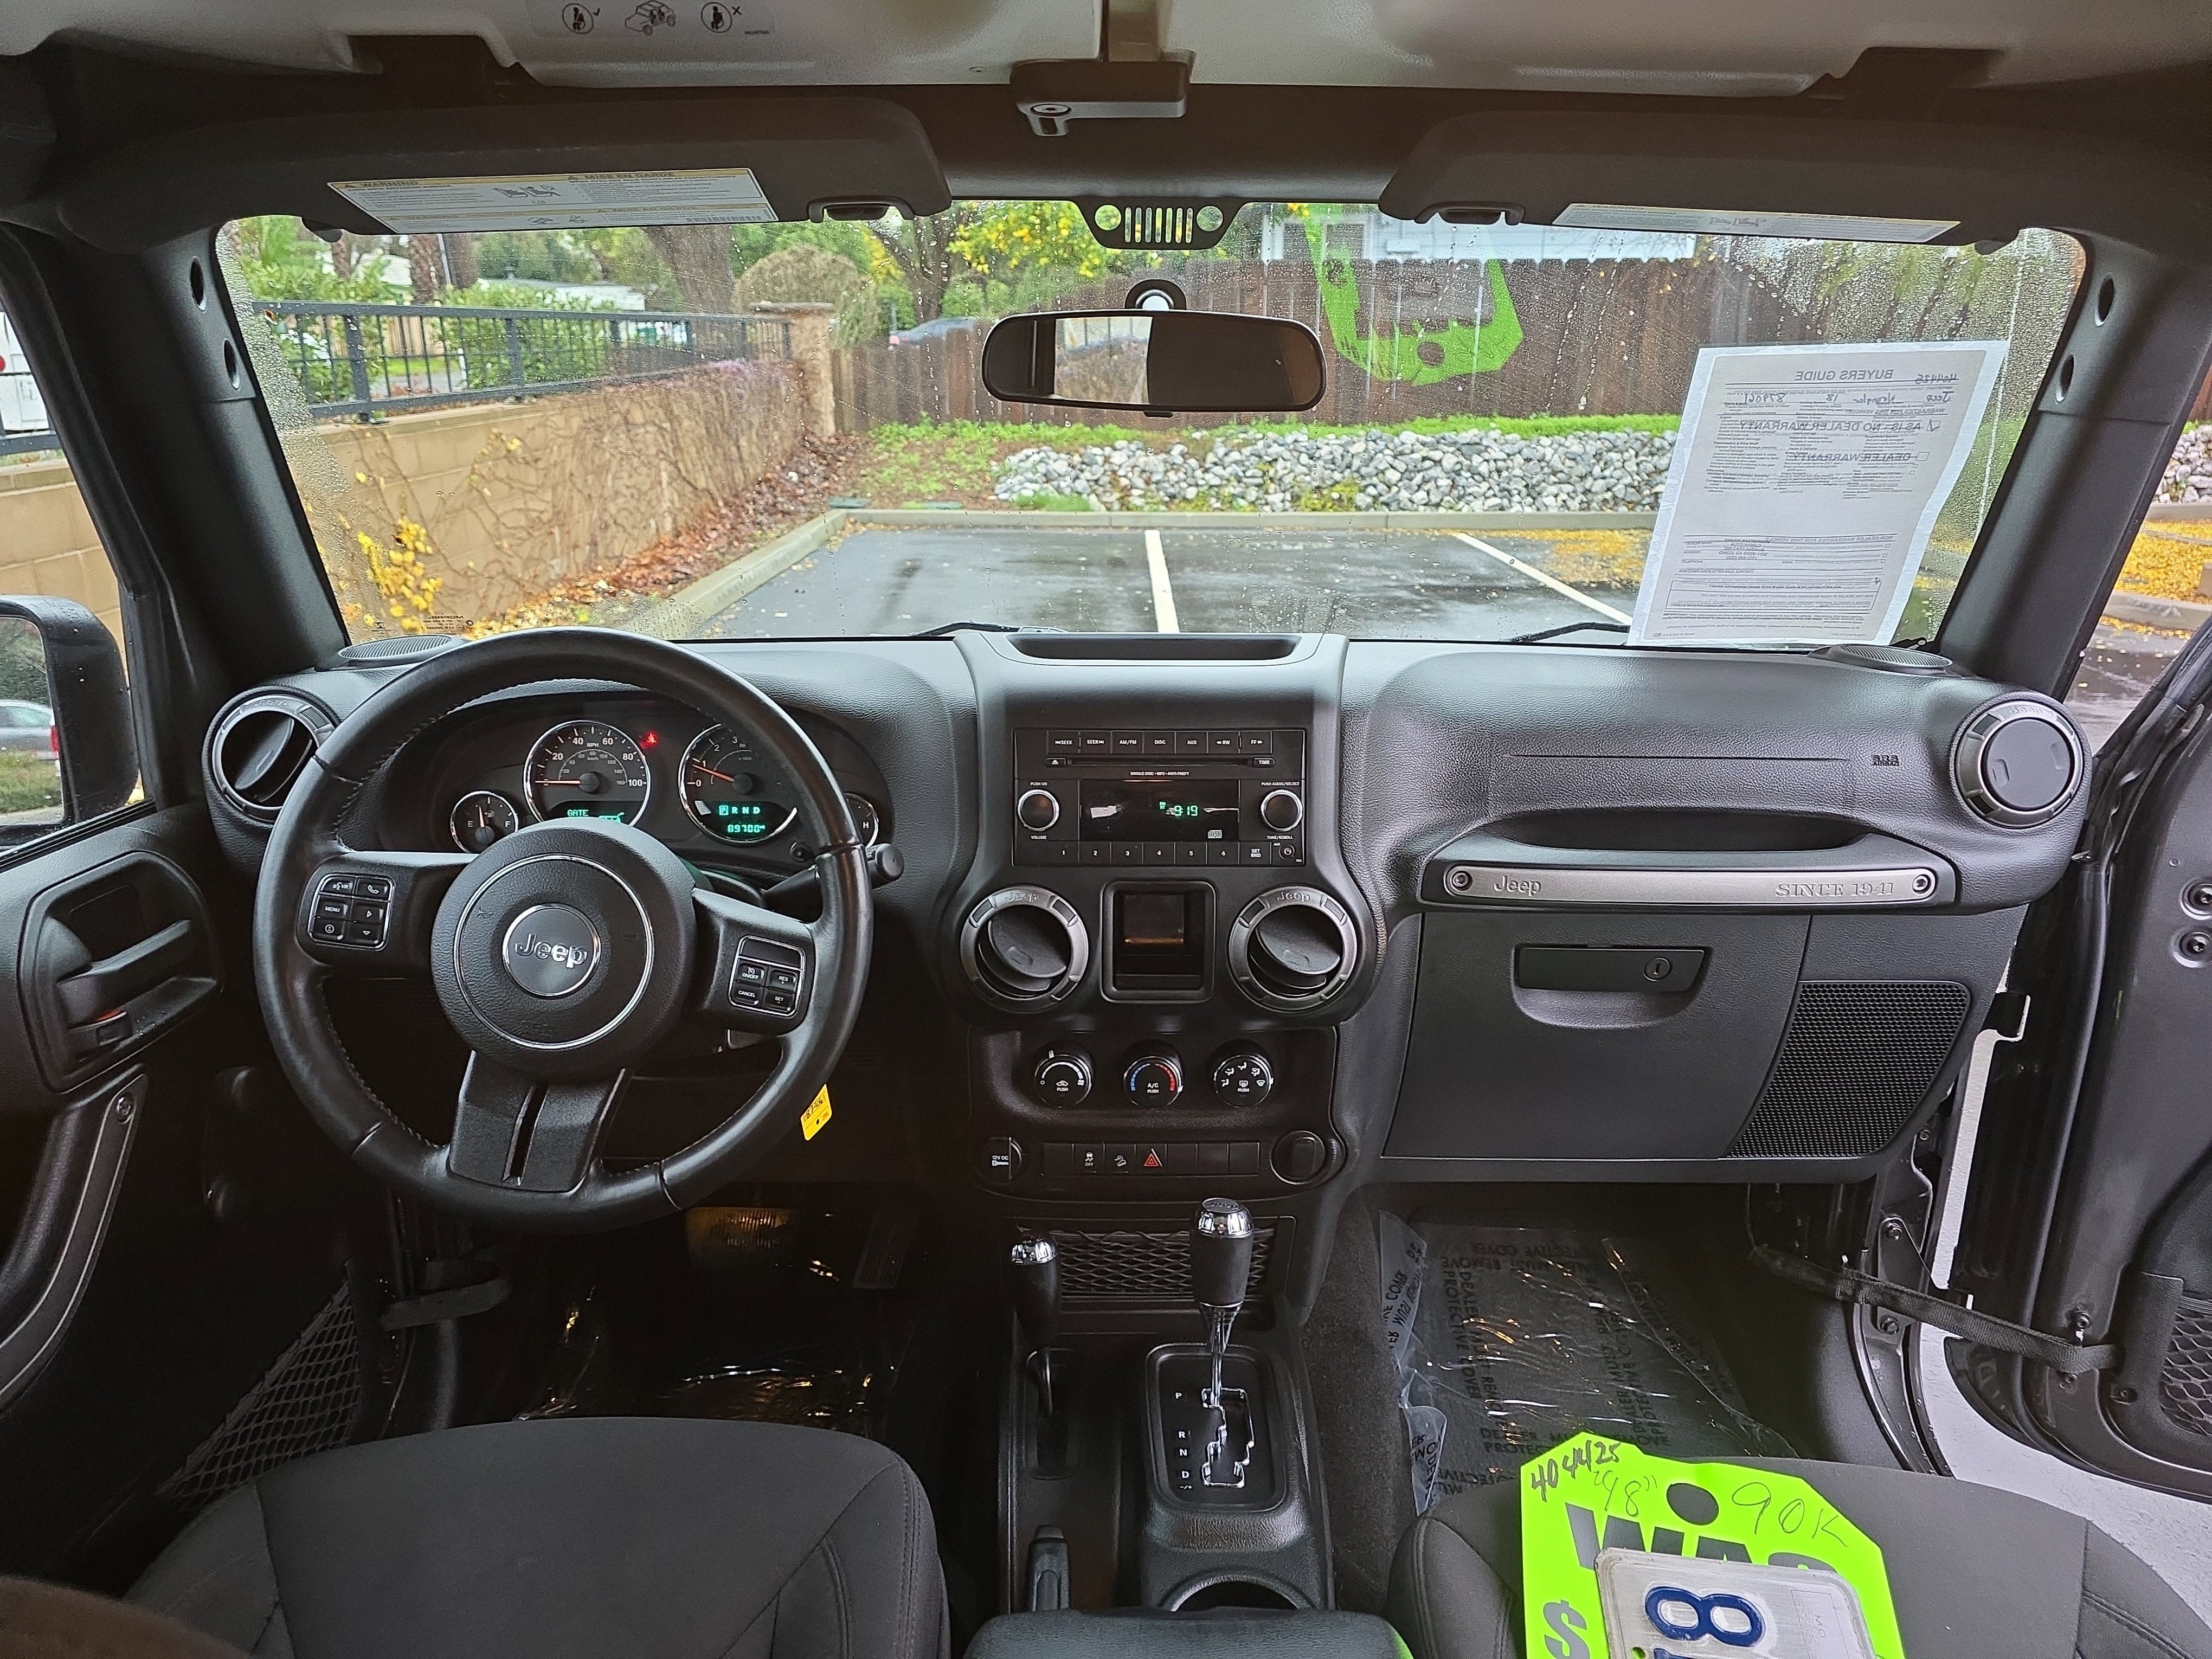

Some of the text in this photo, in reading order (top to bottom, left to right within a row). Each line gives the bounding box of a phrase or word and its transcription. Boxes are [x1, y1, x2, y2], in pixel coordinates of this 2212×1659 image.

[572, 737, 584, 745] 40
[602, 737, 614, 745] 60
[732, 736, 738, 744] 3
[622, 753, 634, 761] 80
[567, 809, 589, 817] GATE
[1493, 875, 1542, 897] Jeep
[1775, 882, 1894, 898] SINCE 1941
[1275, 890, 1311, 903] Jeep
[515, 933, 587, 968] Jeep
[738, 990, 756, 998] CANCEL
[1484, 1442, 1553, 1456] PROTEC
